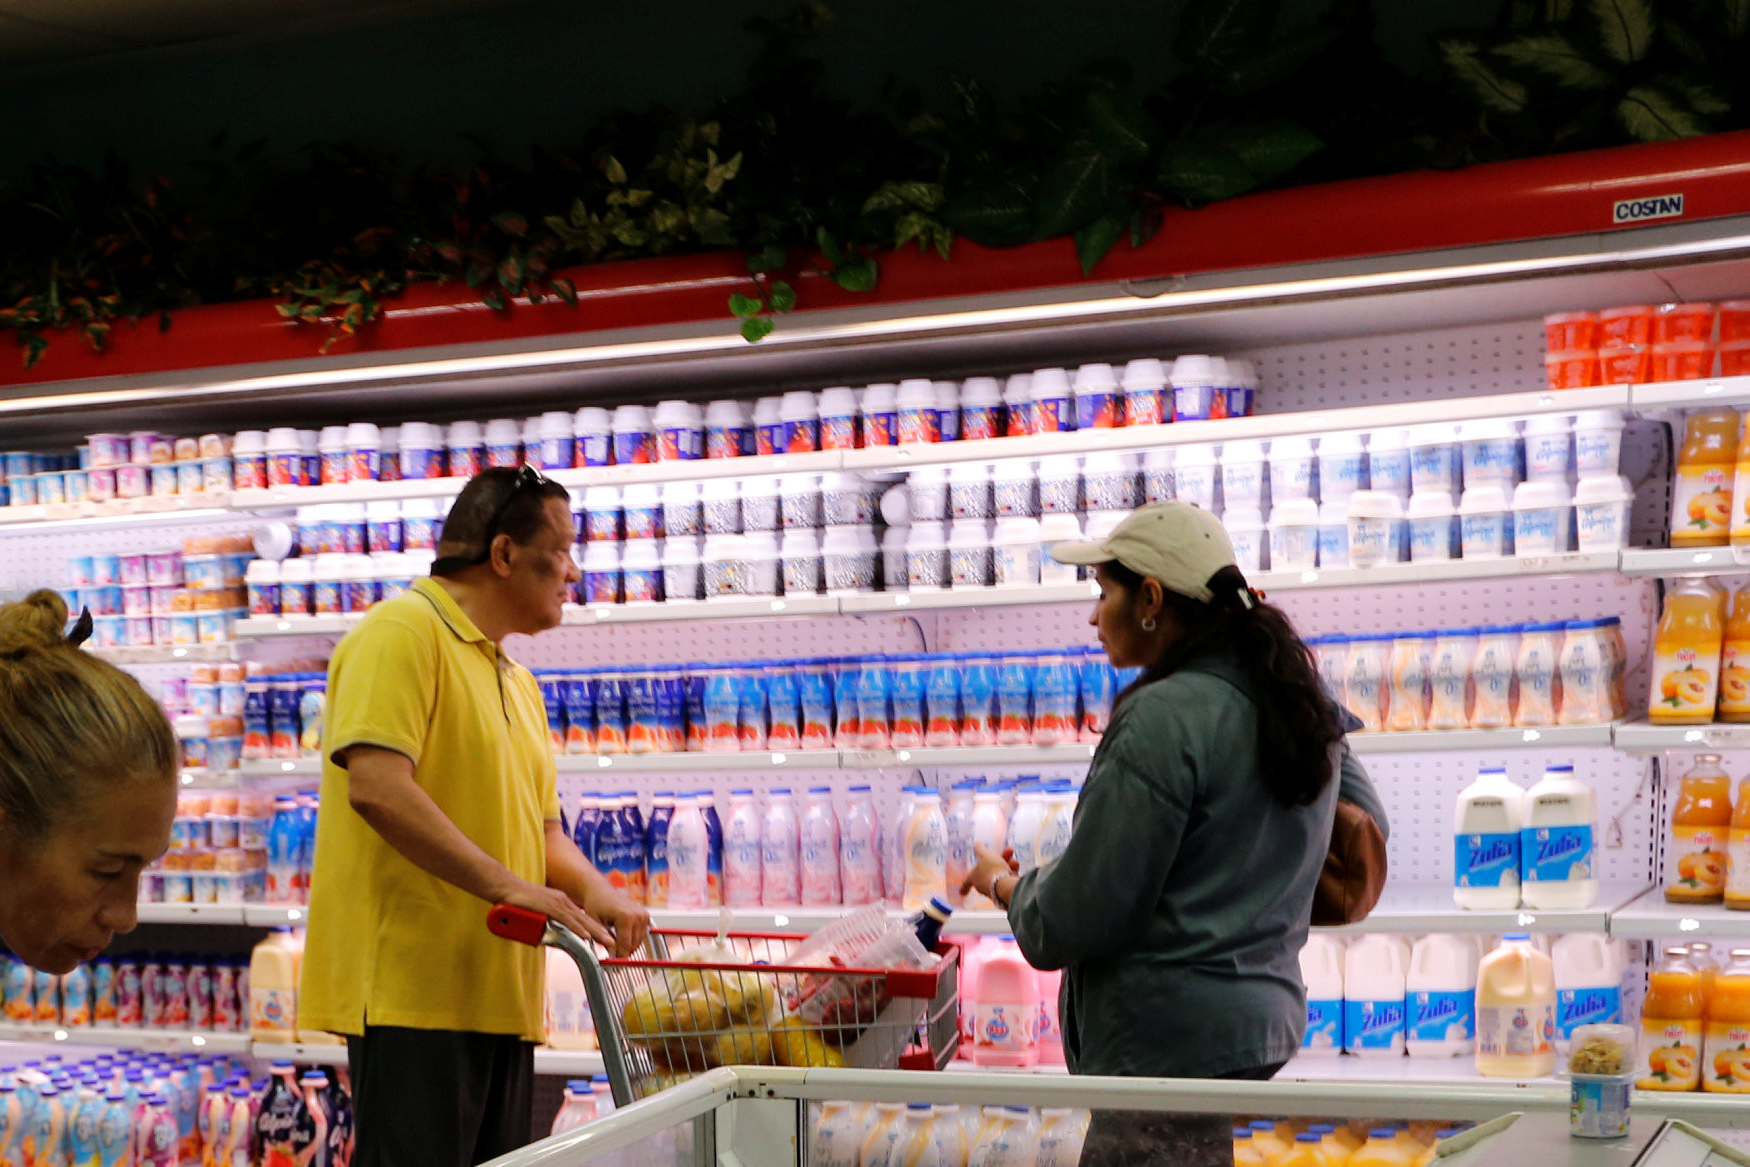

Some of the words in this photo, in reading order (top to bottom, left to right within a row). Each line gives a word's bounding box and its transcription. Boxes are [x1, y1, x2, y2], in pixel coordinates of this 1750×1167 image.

[1615, 195, 1683, 221] COSTAN
[1469, 839, 1513, 869] Zulia
[1536, 831, 1582, 863] Zulia
[1361, 1005, 1403, 1032] Zulia
[1417, 996, 1458, 1022] Zulia
[1563, 993, 1607, 1021] Zulia
